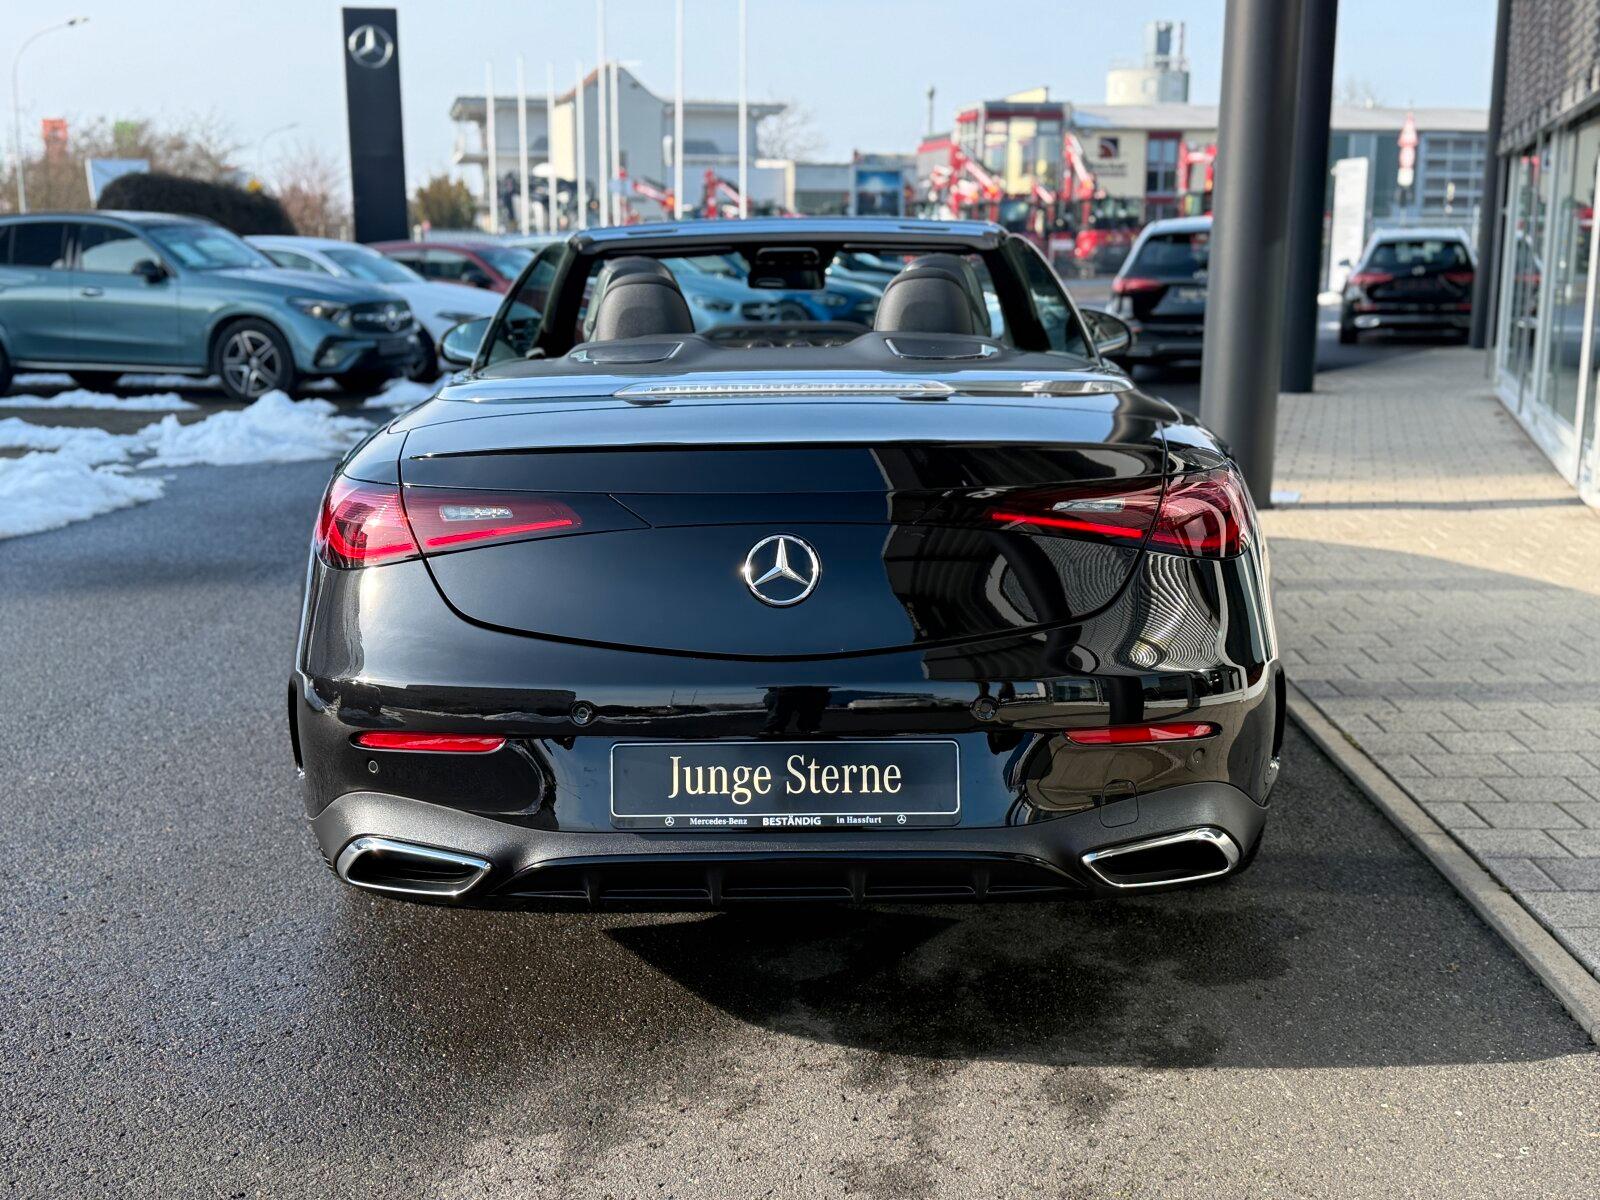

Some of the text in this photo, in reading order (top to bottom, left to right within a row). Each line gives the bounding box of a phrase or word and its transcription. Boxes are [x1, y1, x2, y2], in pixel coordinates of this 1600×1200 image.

[668, 754, 902, 805] Junge Sterne
[689, 814, 882, 827] Mercedes-Benz BESTÄNDIG in Hassfurt
